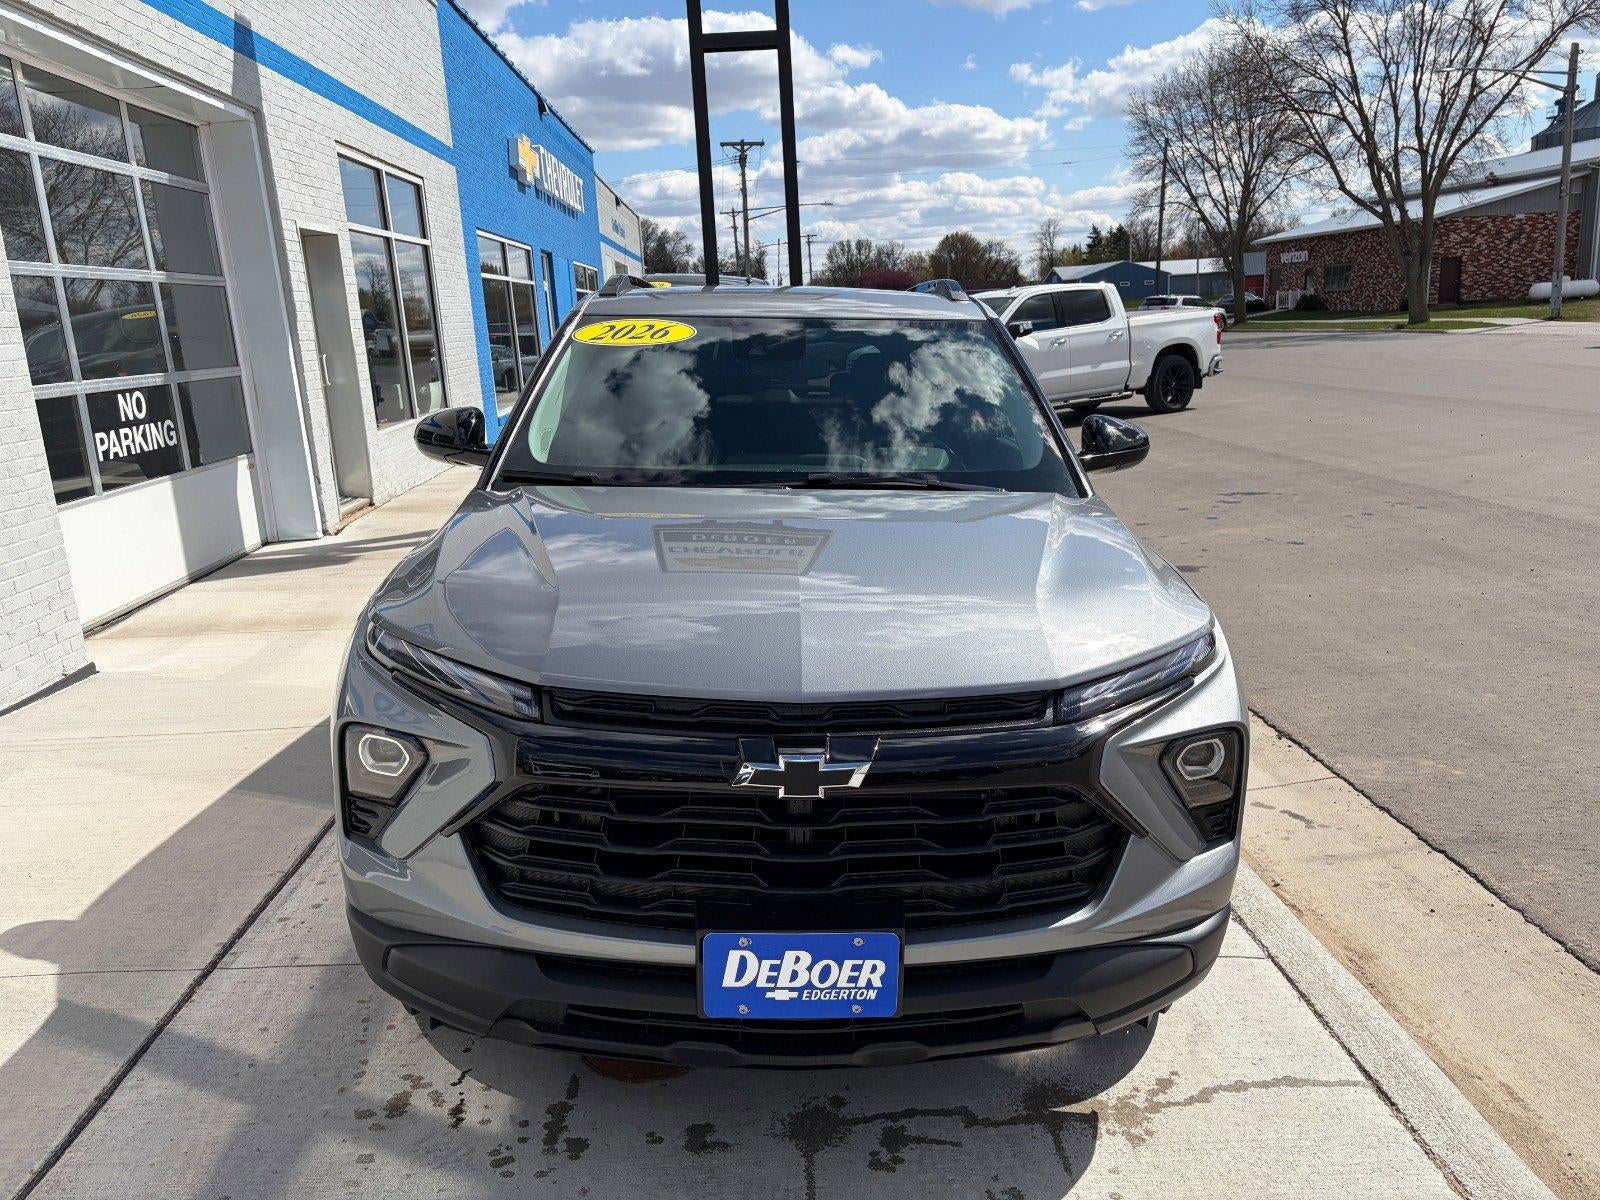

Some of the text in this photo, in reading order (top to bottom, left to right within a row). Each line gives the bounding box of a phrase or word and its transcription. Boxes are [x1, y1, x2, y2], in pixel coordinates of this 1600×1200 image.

[536, 145, 585, 213] CHEVROLET
[1281, 250, 1308, 263] verizon
[588, 324, 677, 341] 2026
[117, 390, 147, 422] NO
[94, 419, 178, 462] PARKING
[802, 989, 878, 1001] EDGERTON
